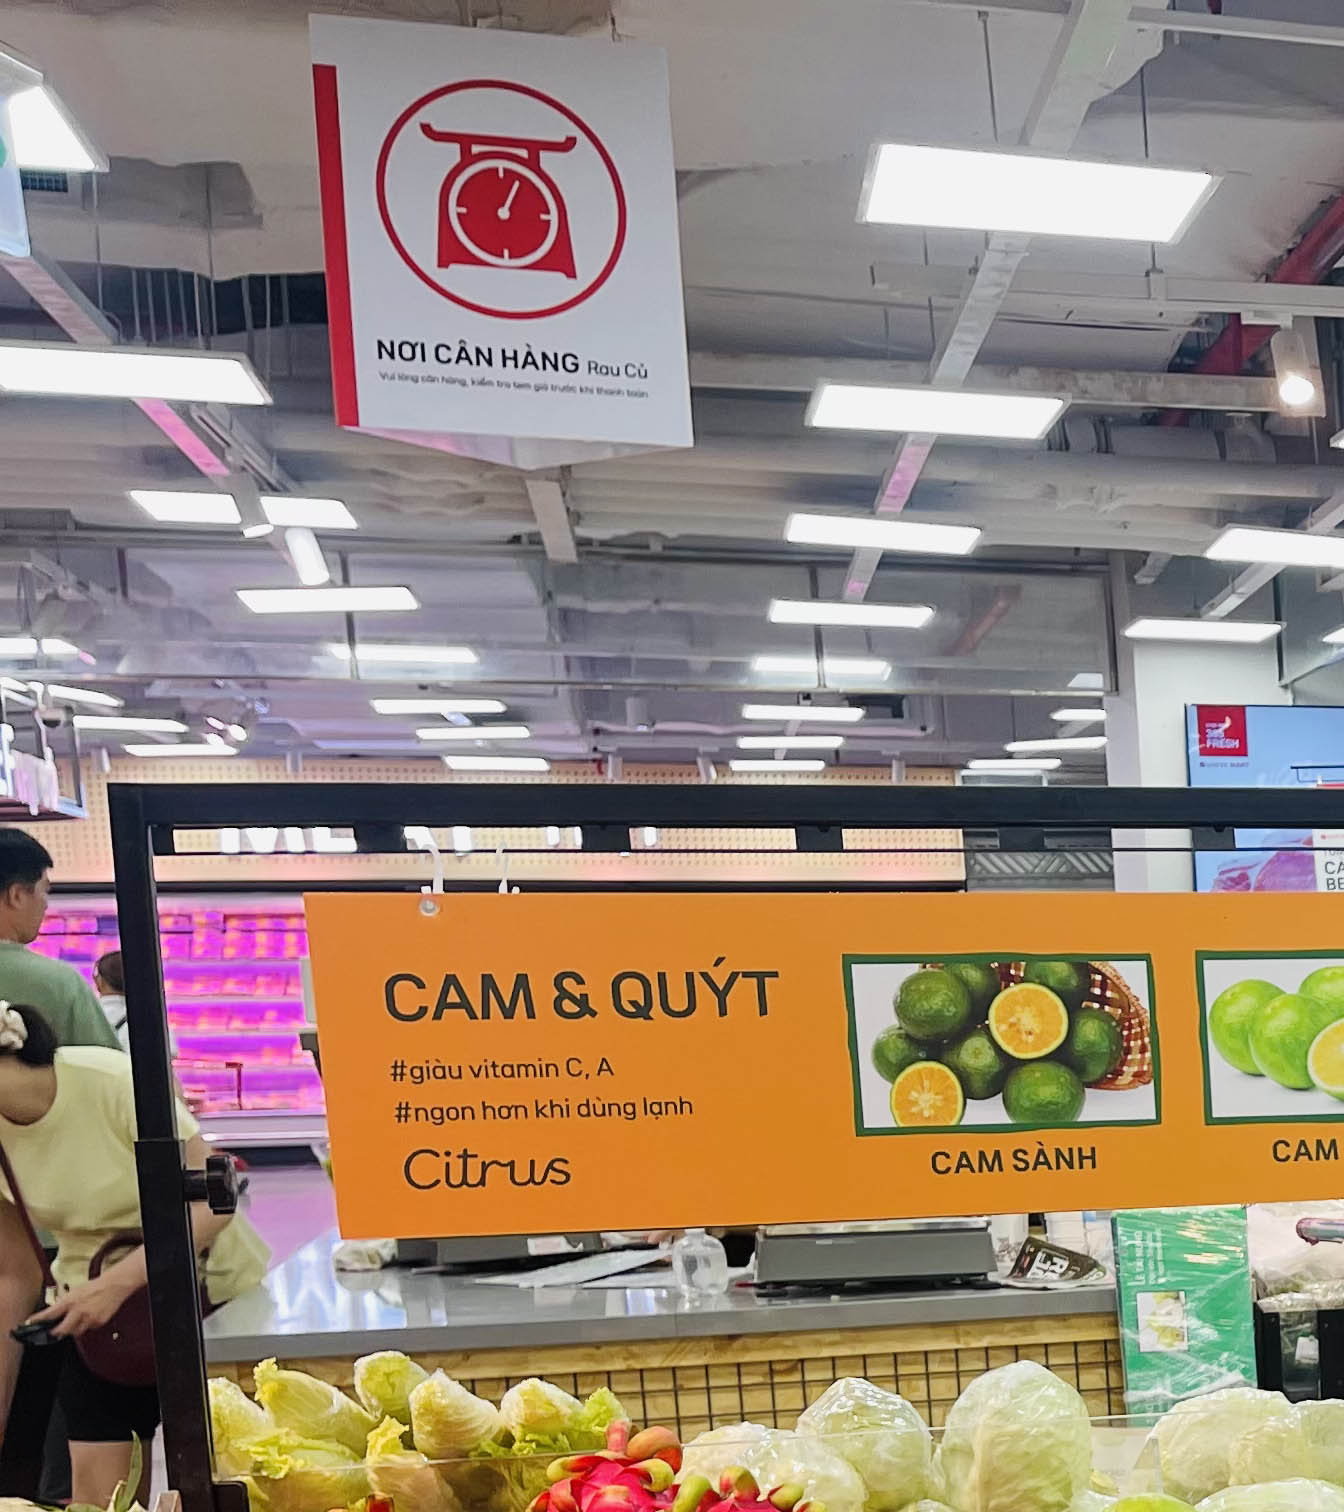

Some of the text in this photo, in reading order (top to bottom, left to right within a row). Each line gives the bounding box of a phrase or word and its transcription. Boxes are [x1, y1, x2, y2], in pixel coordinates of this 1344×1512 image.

[377, 339, 648, 379] NƠI CÂN HÀNG Rau Củ
[384, 956, 780, 1022] CAM & QUÝT
[390, 1057, 615, 1085] #giàu vitamin C, A
[394, 1096, 694, 1126] #ngon hơn khi dùng lạnh
[931, 1141, 1097, 1175] CAM SÀNH
[1271, 1137, 1339, 1163] CAM
[403, 1147, 572, 1190] Citrus
